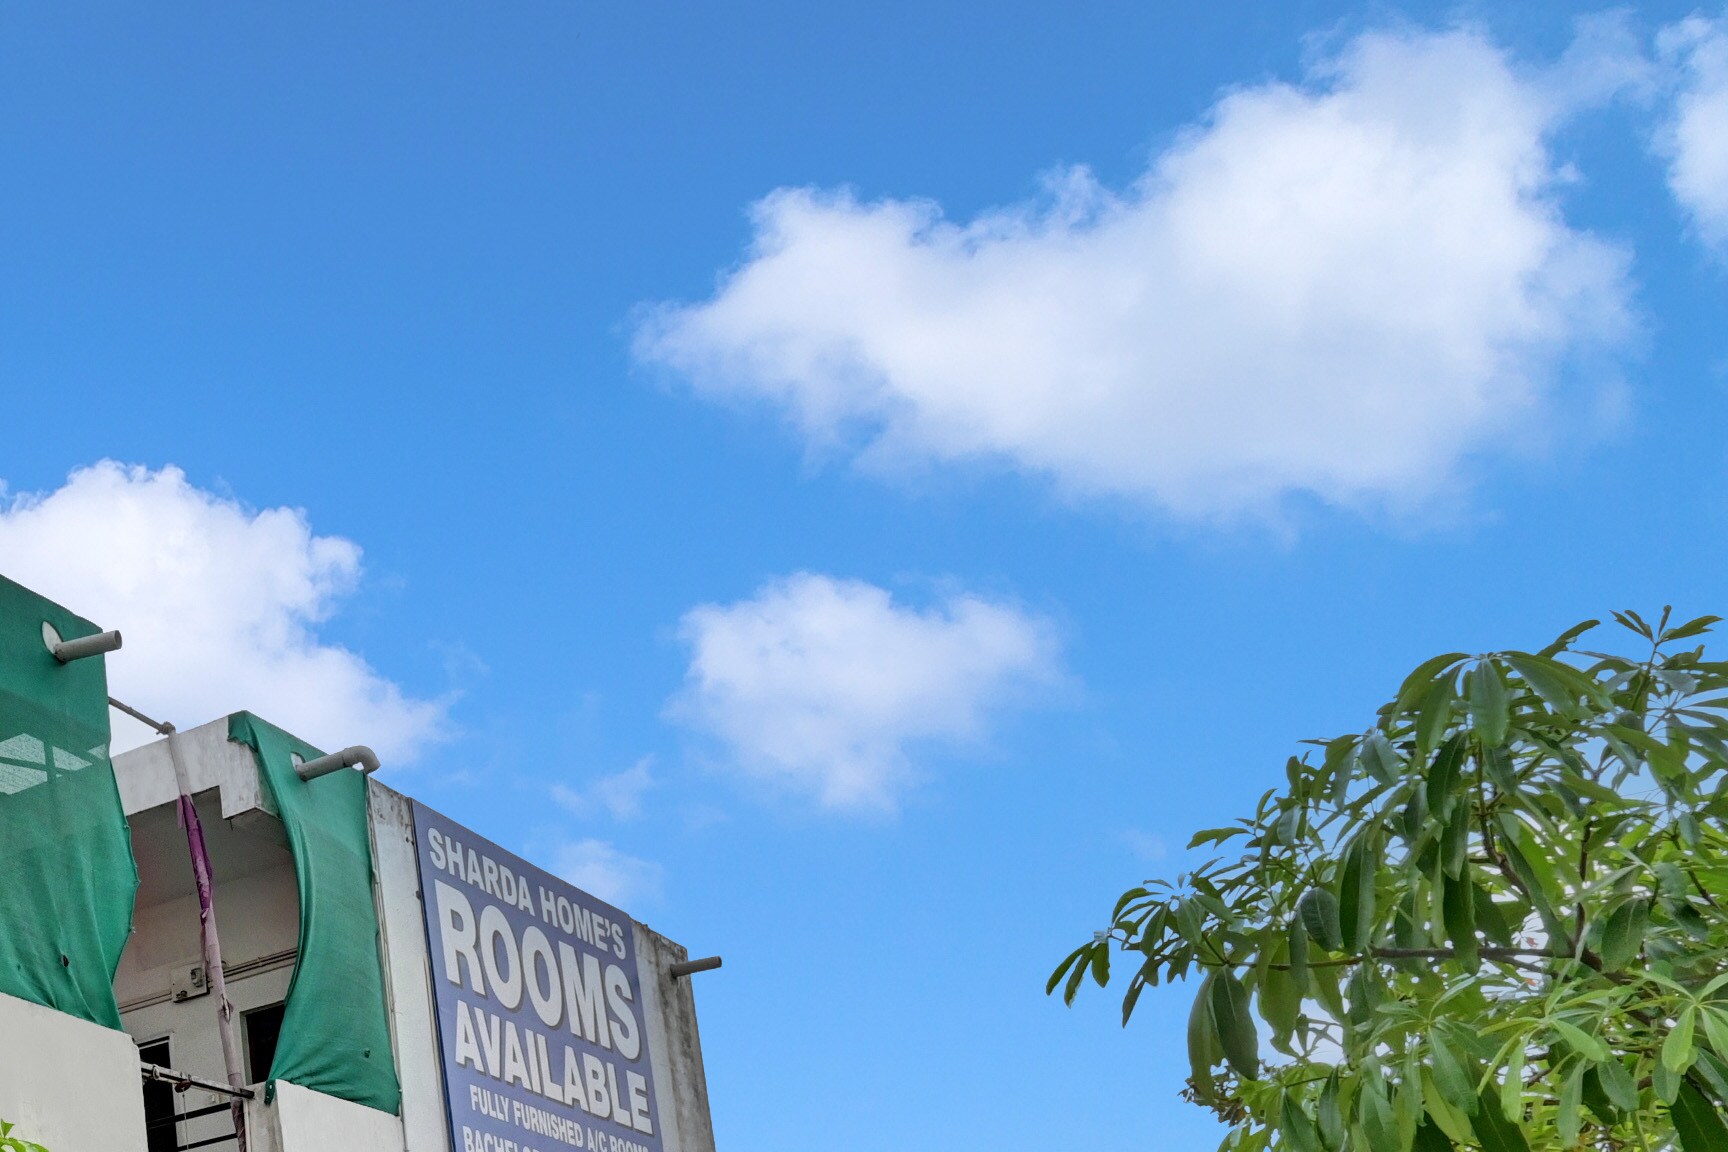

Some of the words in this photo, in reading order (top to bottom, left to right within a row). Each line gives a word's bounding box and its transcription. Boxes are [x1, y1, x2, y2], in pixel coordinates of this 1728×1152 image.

[427, 827, 536, 917] SHARDA
[539, 885, 627, 960] HOME'S
[434, 878, 642, 1061] ROOMS
[455, 999, 654, 1136] AVAILABLE
[469, 1084, 510, 1123] FULLY
[513, 1100, 584, 1149] FURNISHED
